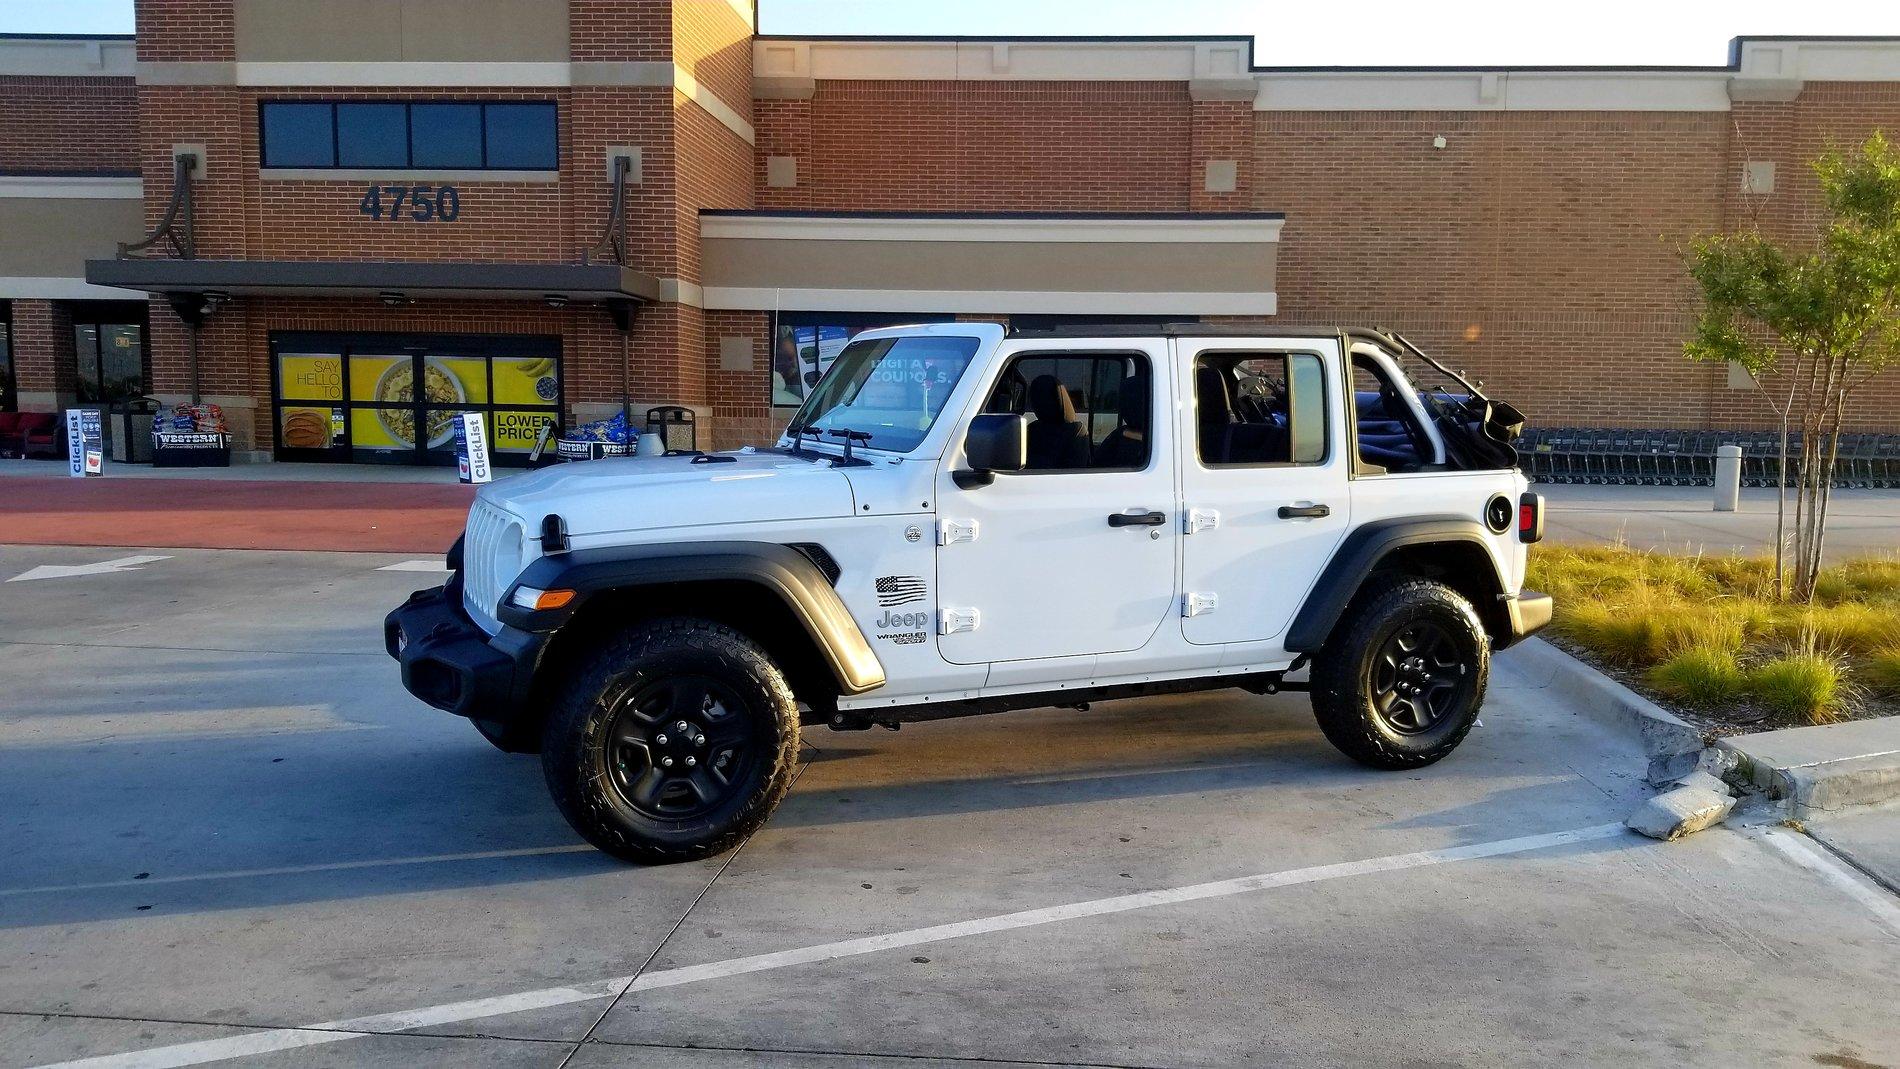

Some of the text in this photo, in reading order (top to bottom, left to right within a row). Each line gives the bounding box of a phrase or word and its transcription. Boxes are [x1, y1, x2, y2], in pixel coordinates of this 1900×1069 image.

[361, 186, 460, 222] 4750
[314, 361, 340, 373] SAY
[871, 360, 929, 369] DIGITA
[297, 373, 340, 386] HELLO
[873, 371, 952, 384] COUPOS.
[322, 386, 341, 398] TO
[497, 415, 552, 427] LOWER
[160, 434, 218, 443] WESTERN
[498, 428, 553, 440] PRICE
[71, 415, 81, 473] ClickList
[470, 419, 486, 479] ClickList
[877, 610, 929, 629] Jeep
[877, 632, 927, 640] WRANGLER
